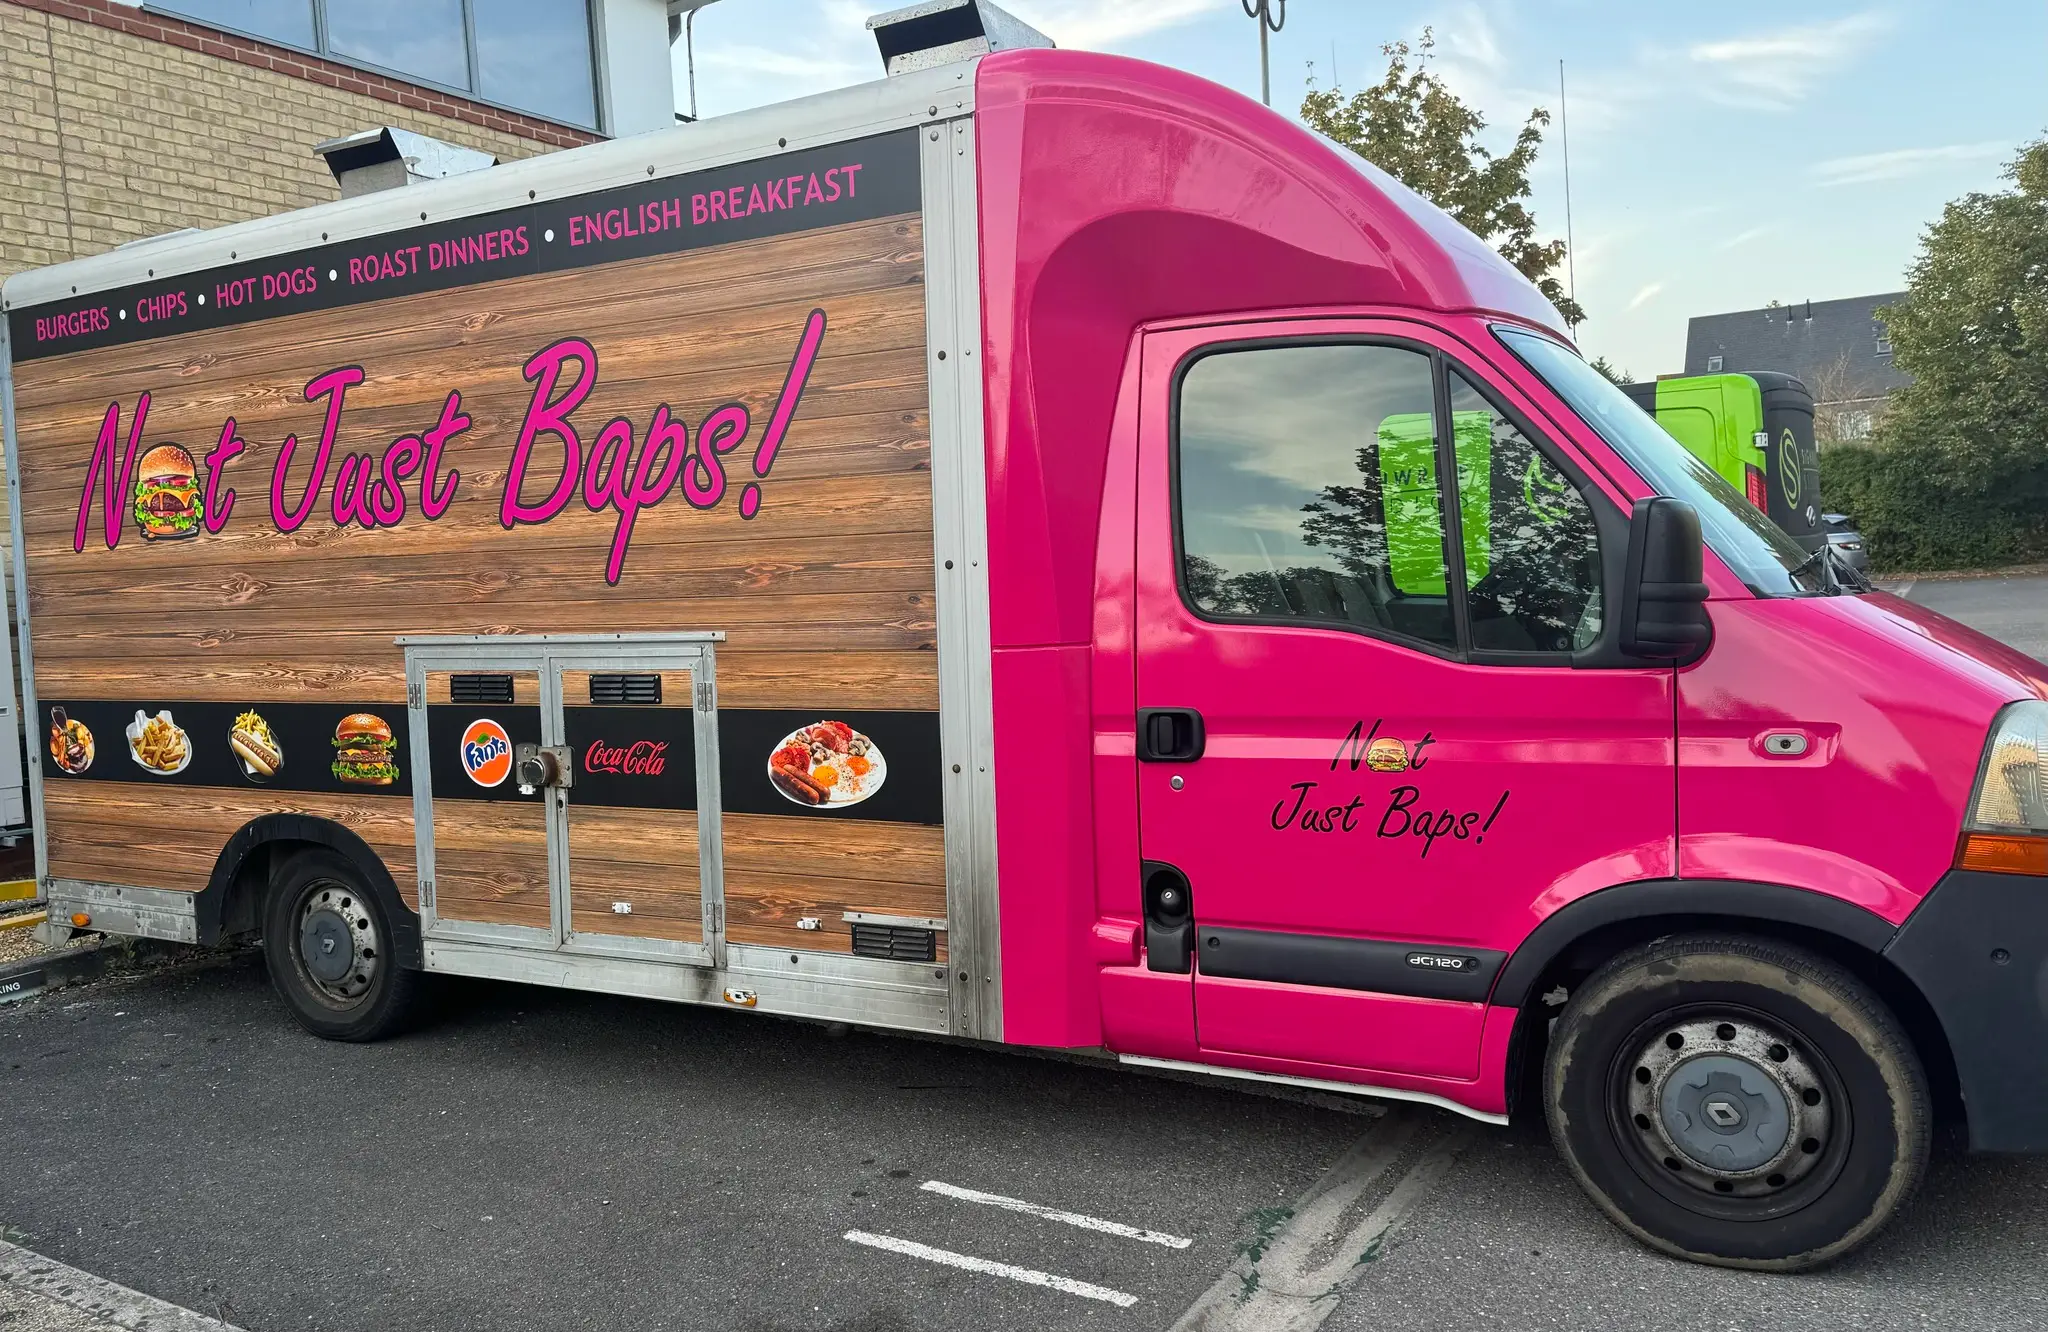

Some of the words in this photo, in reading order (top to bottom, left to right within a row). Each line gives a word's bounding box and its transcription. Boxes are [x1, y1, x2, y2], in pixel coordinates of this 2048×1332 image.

[36, 306, 110, 341] BURGERS
[136, 291, 188, 323] CHIPS
[216, 278, 256, 308] HOT
[262, 266, 317, 300] DOGS
[349, 246, 421, 285] ROAST
[429, 226, 529, 271] DINNERS
[569, 198, 681, 246] ENGLISH
[692, 163, 862, 225] BREAKFAST
[74, 390, 245, 553] Nt
[270, 364, 471, 534] Just
[500, 307, 828, 586] Baps!
[464, 737, 507, 772] Fanta
[584, 739, 671, 776] Coca-Cola
[1330, 718, 1436, 772] Nt
[1271, 781, 1365, 833] Just
[1376, 785, 1510, 859] Baps!
